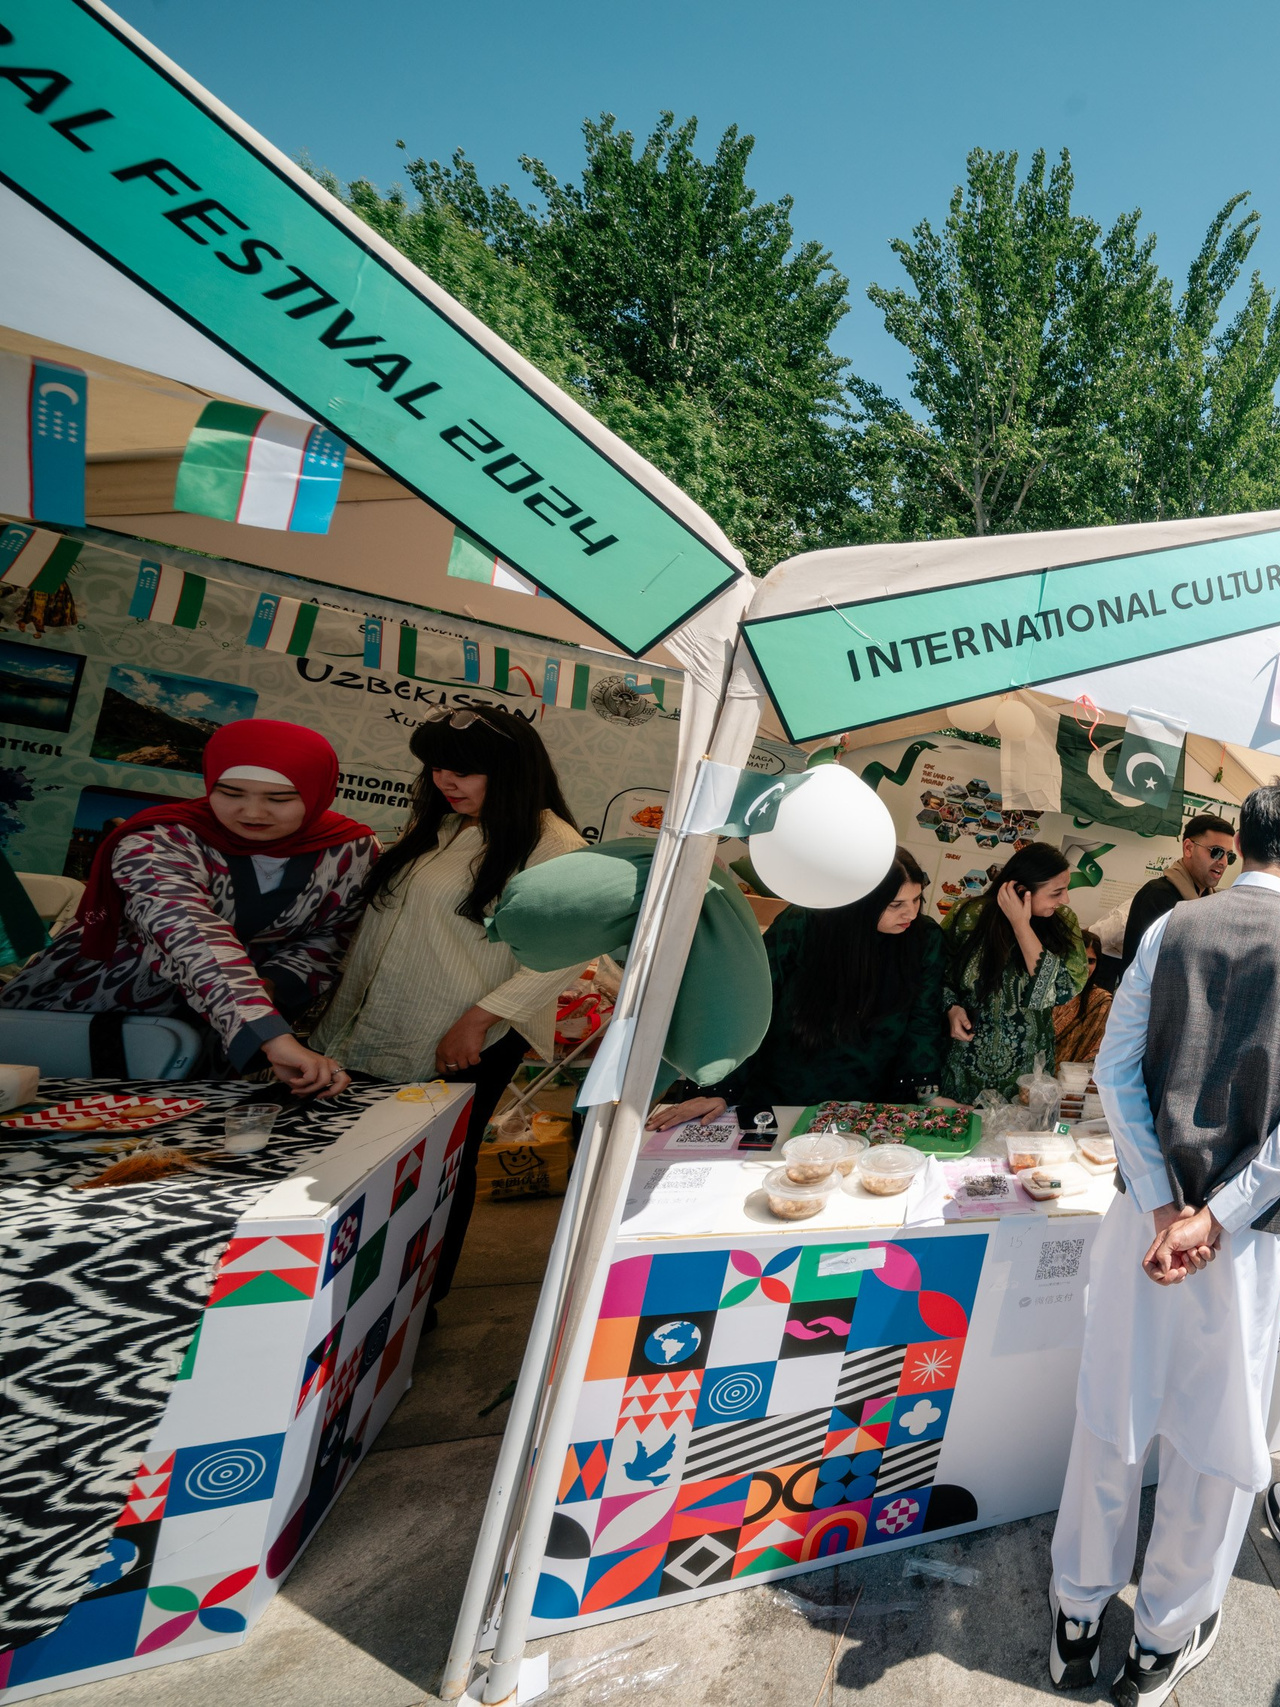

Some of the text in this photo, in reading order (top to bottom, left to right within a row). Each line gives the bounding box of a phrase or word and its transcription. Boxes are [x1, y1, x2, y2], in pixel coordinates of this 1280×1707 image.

[0, 22, 619, 557] AL FESTIVAL 2024
[847, 587, 1166, 683] INTERNATIONAL
